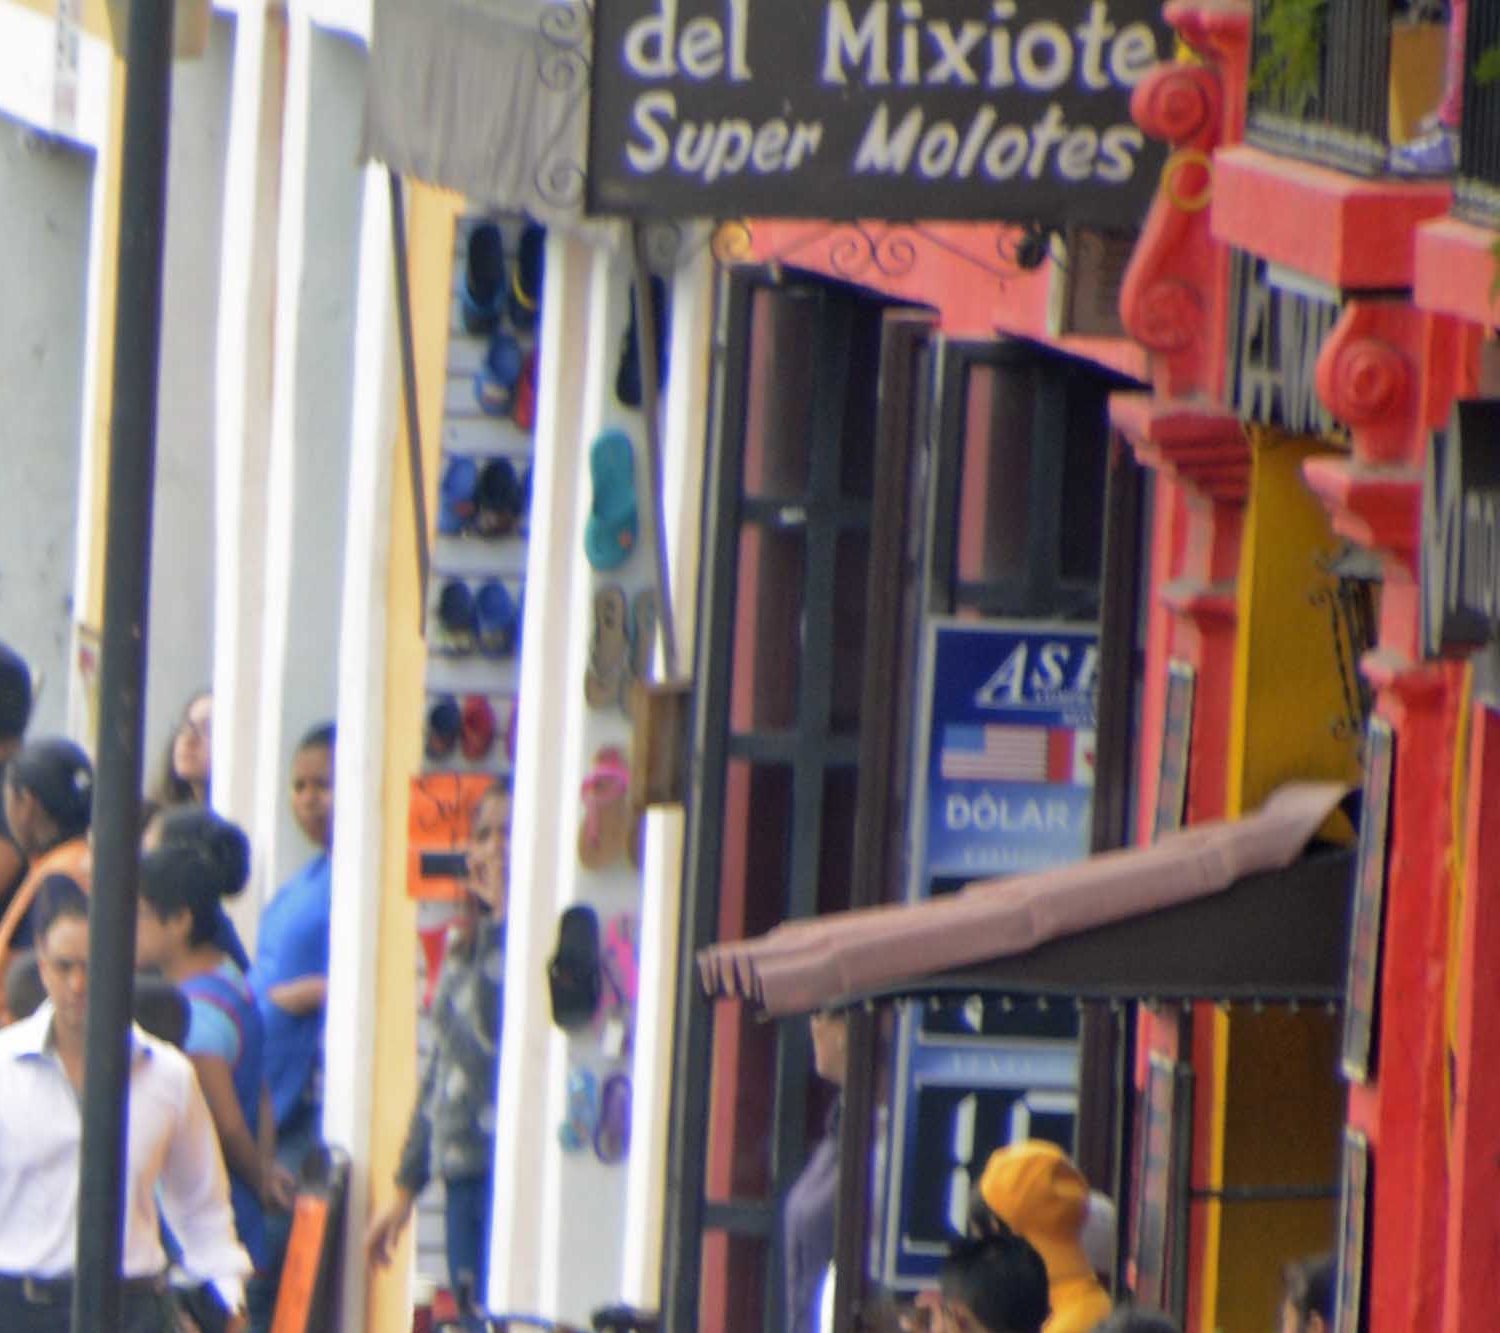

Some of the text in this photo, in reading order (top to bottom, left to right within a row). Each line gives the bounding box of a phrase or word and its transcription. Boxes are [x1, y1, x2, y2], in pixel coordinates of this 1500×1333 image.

[622, 0, 1157, 92] del Mixiote
[625, 92, 1145, 184] Super Molotes
